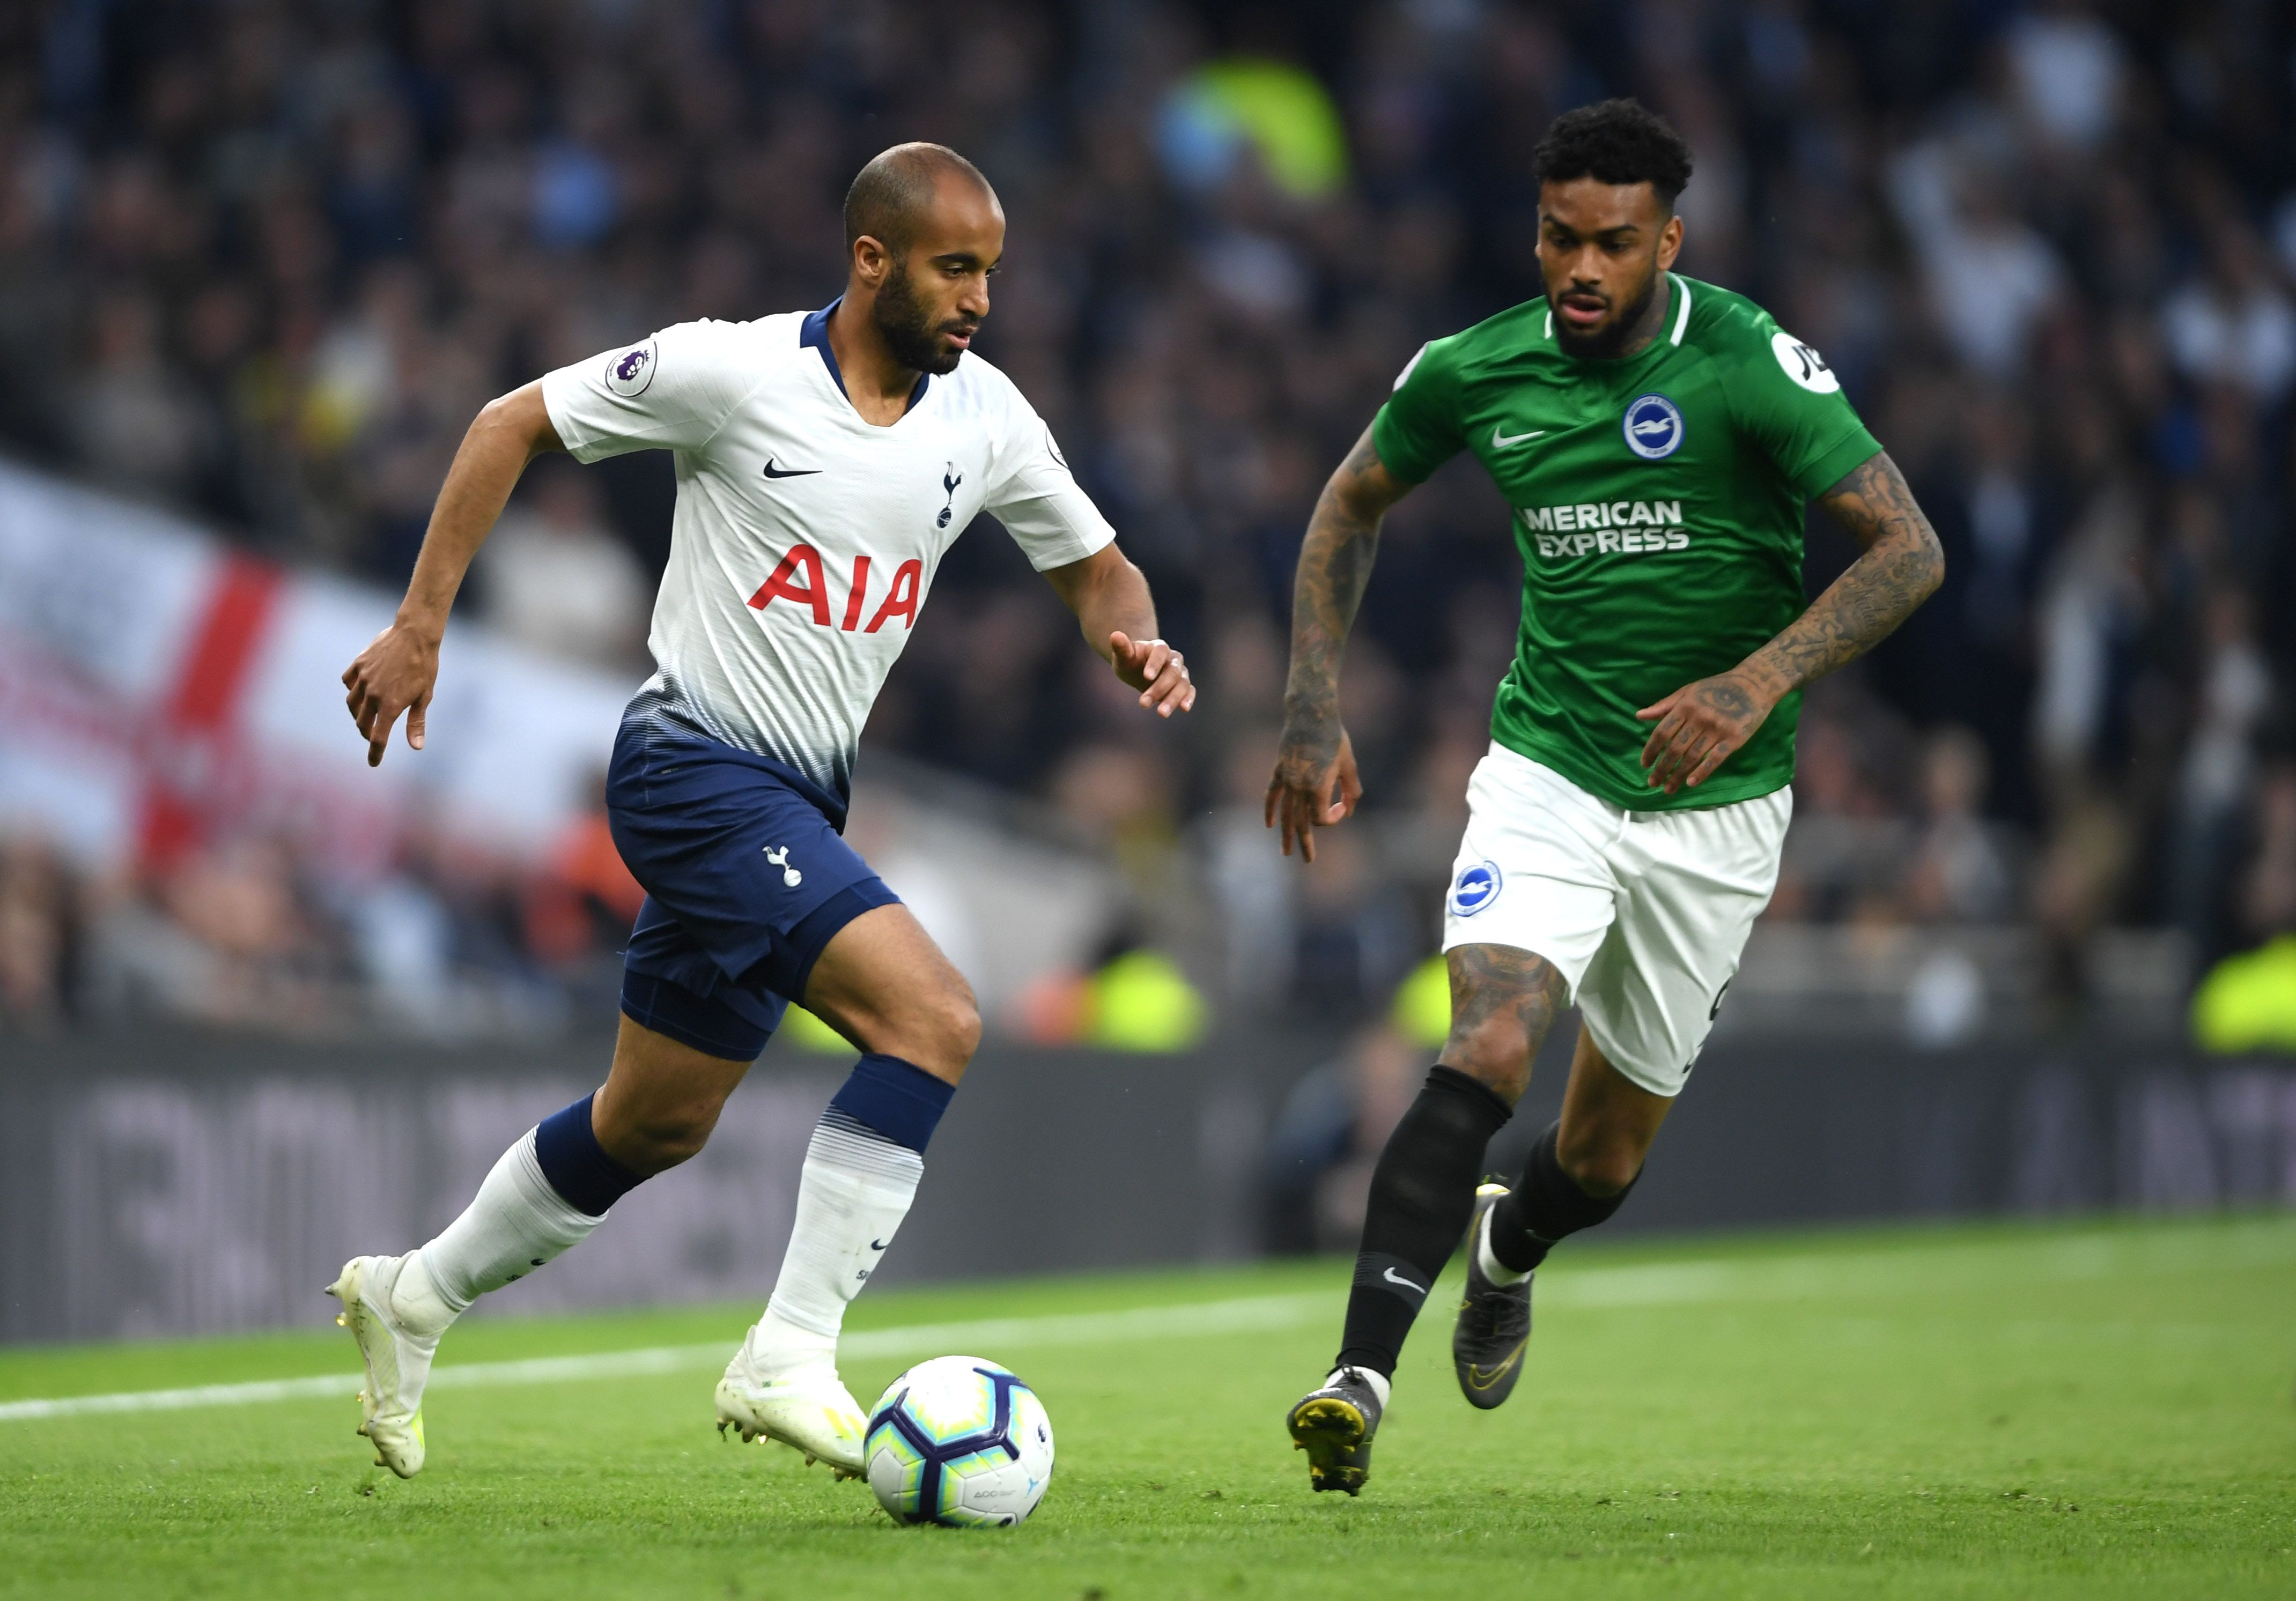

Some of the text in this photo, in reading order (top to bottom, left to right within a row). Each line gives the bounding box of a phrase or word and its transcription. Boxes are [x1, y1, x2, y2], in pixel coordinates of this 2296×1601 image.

[1517, 501, 1682, 531] MERICAN
[1535, 527, 1689, 557] EXPRESS
[747, 544, 921, 633] AIA
